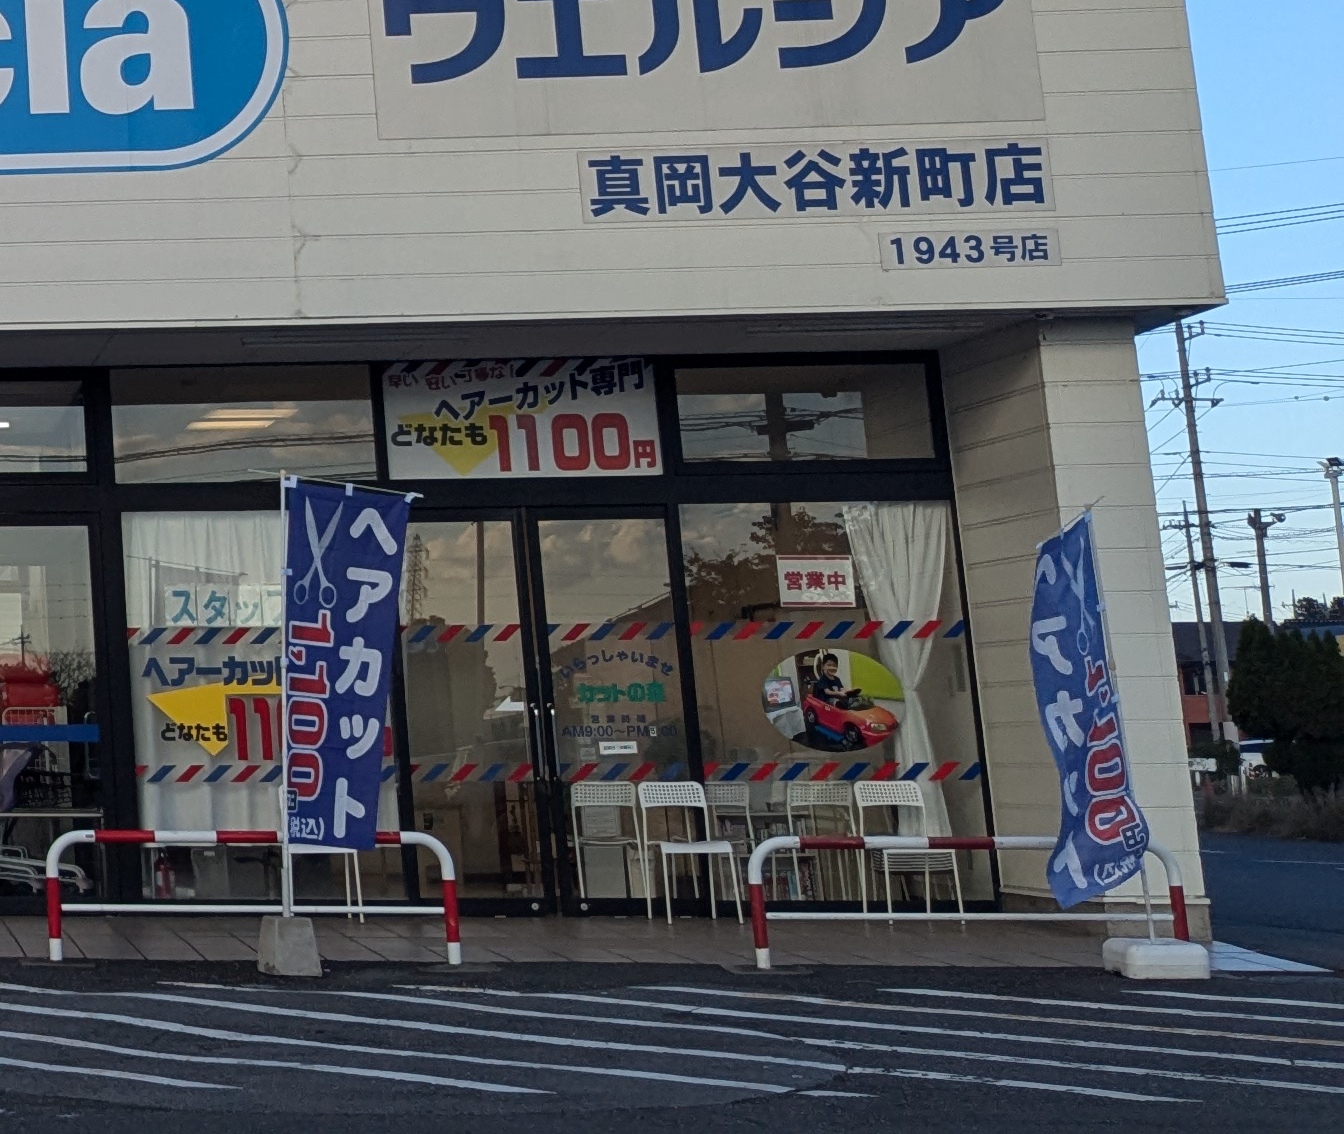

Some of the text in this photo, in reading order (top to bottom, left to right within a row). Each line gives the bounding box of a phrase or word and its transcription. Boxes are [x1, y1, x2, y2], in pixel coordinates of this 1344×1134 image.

[587, 143, 1047, 218] 真岡大谷新町店
[889, 233, 1051, 266] 1943号店
[433, 357, 644, 421] ヘアーカット専門
[390, 412, 657, 472] どなたも 1100円
[784, 570, 847, 591] 営業中
[332, 507, 398, 840] ヘアカット
[559, 649, 674, 679] いらっしゃいませ
[161, 697, 282, 761] どなたも 11
